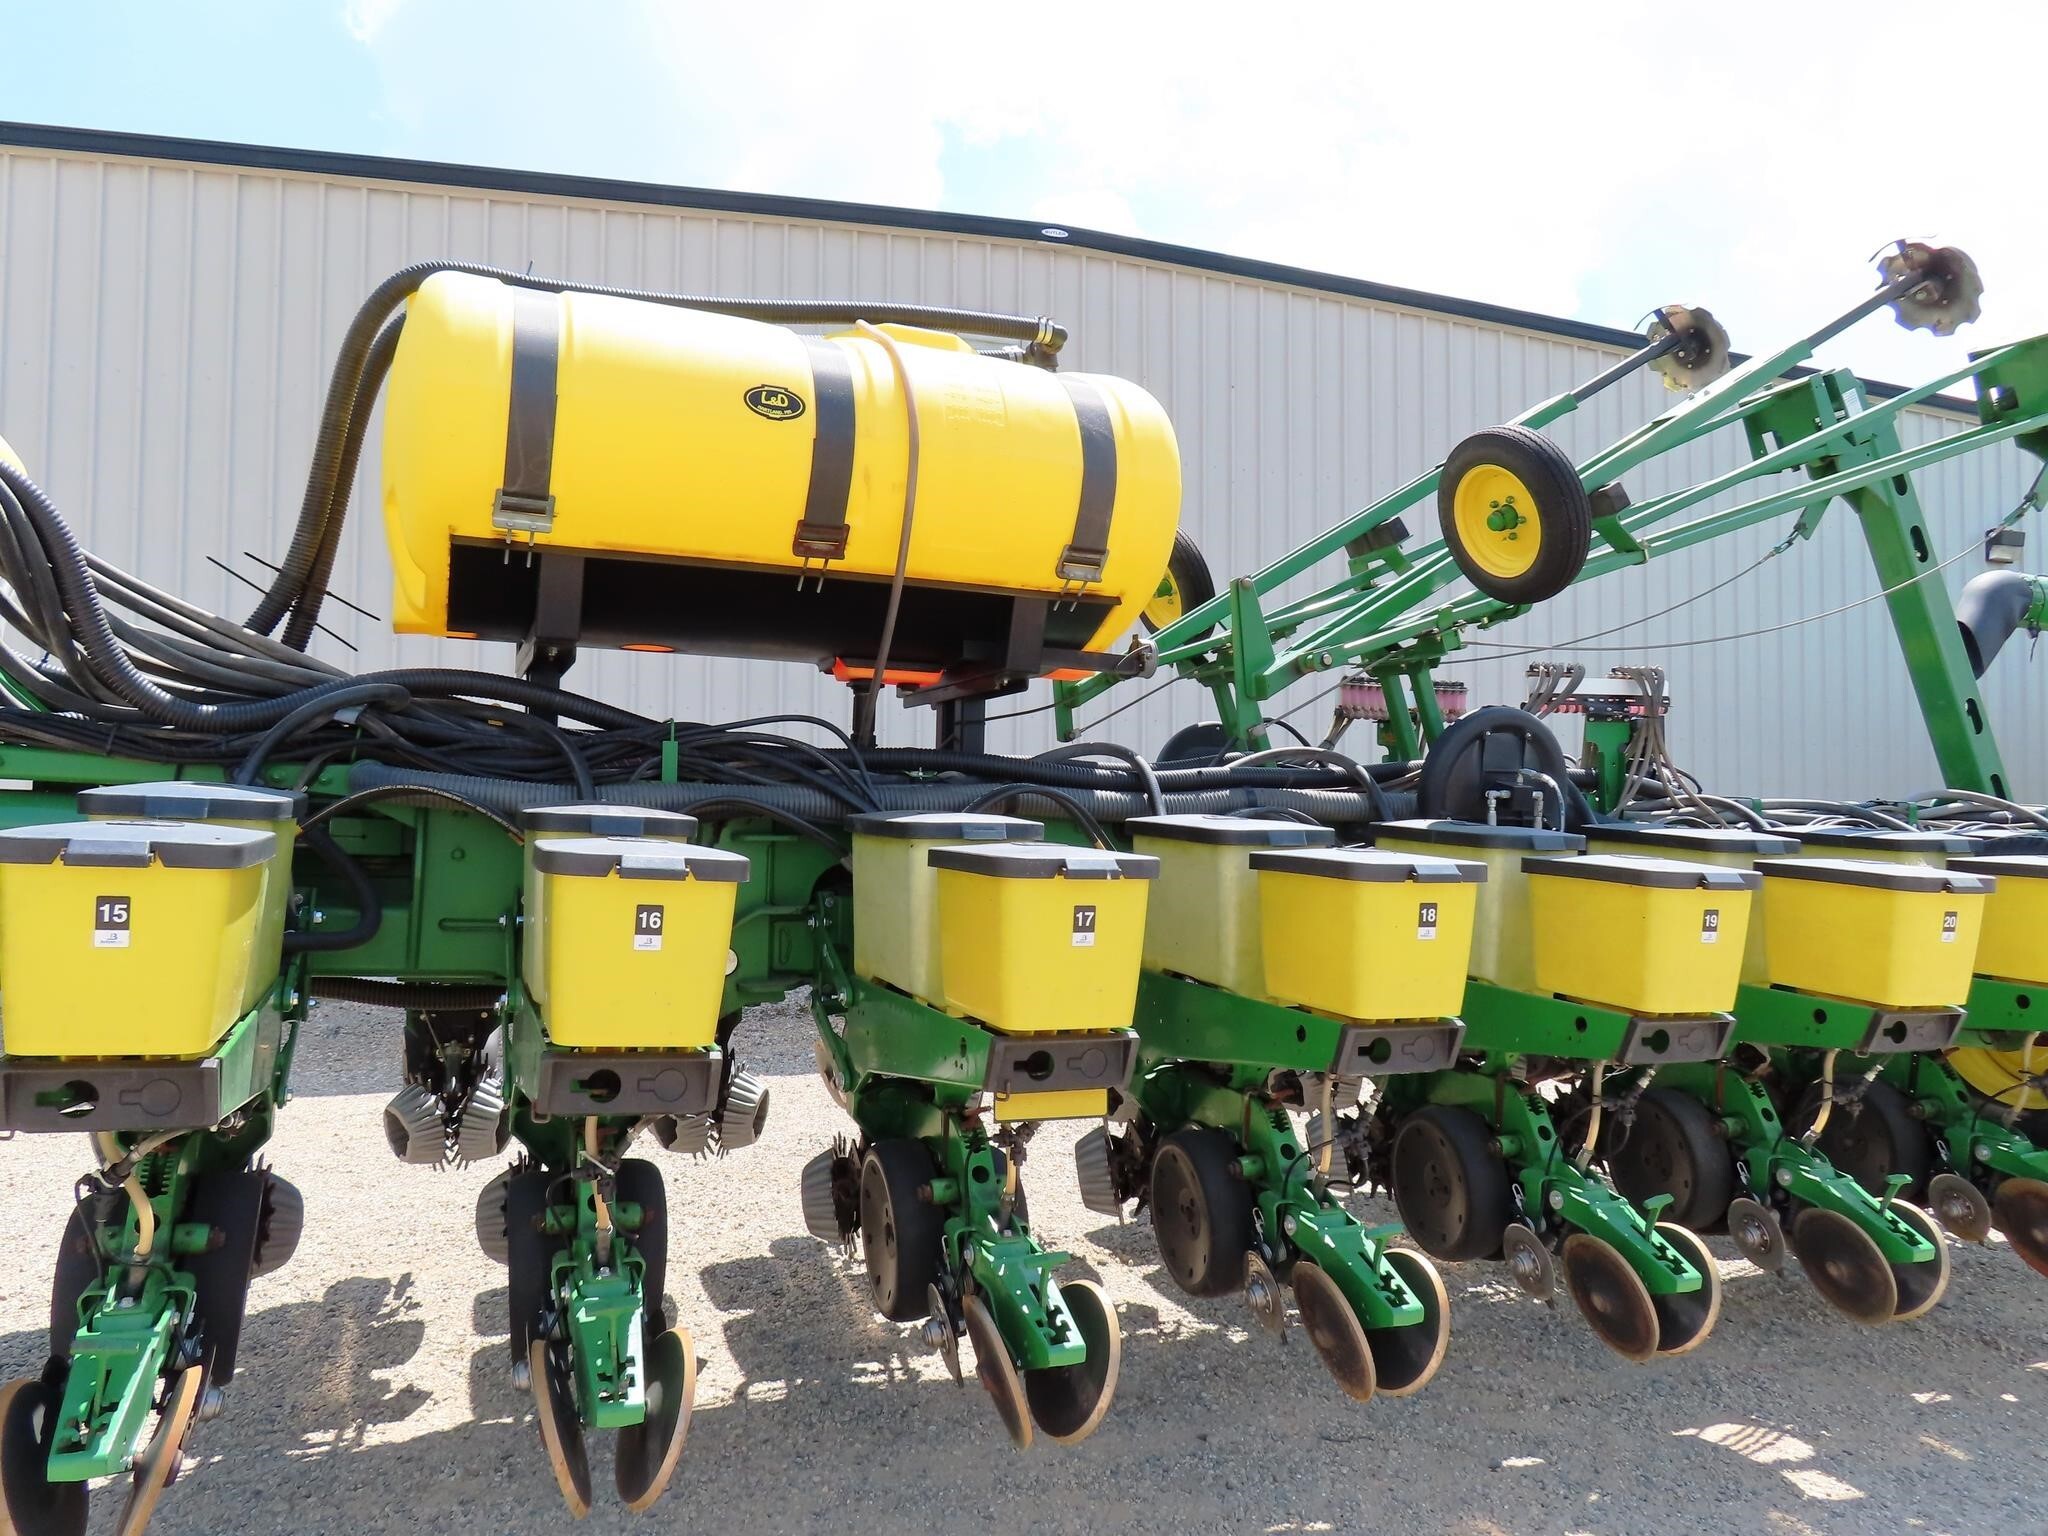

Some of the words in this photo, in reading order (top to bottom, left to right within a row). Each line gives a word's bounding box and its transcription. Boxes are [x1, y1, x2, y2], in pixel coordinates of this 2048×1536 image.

[761, 391, 789, 407] L&D
[99, 903, 128, 923] 15
[639, 911, 662, 929] 16
[1076, 911, 1095, 927] 17
[1421, 908, 1436, 922] 18
[1705, 914, 1718, 927] 19
[1944, 916, 1956, 928] 20
